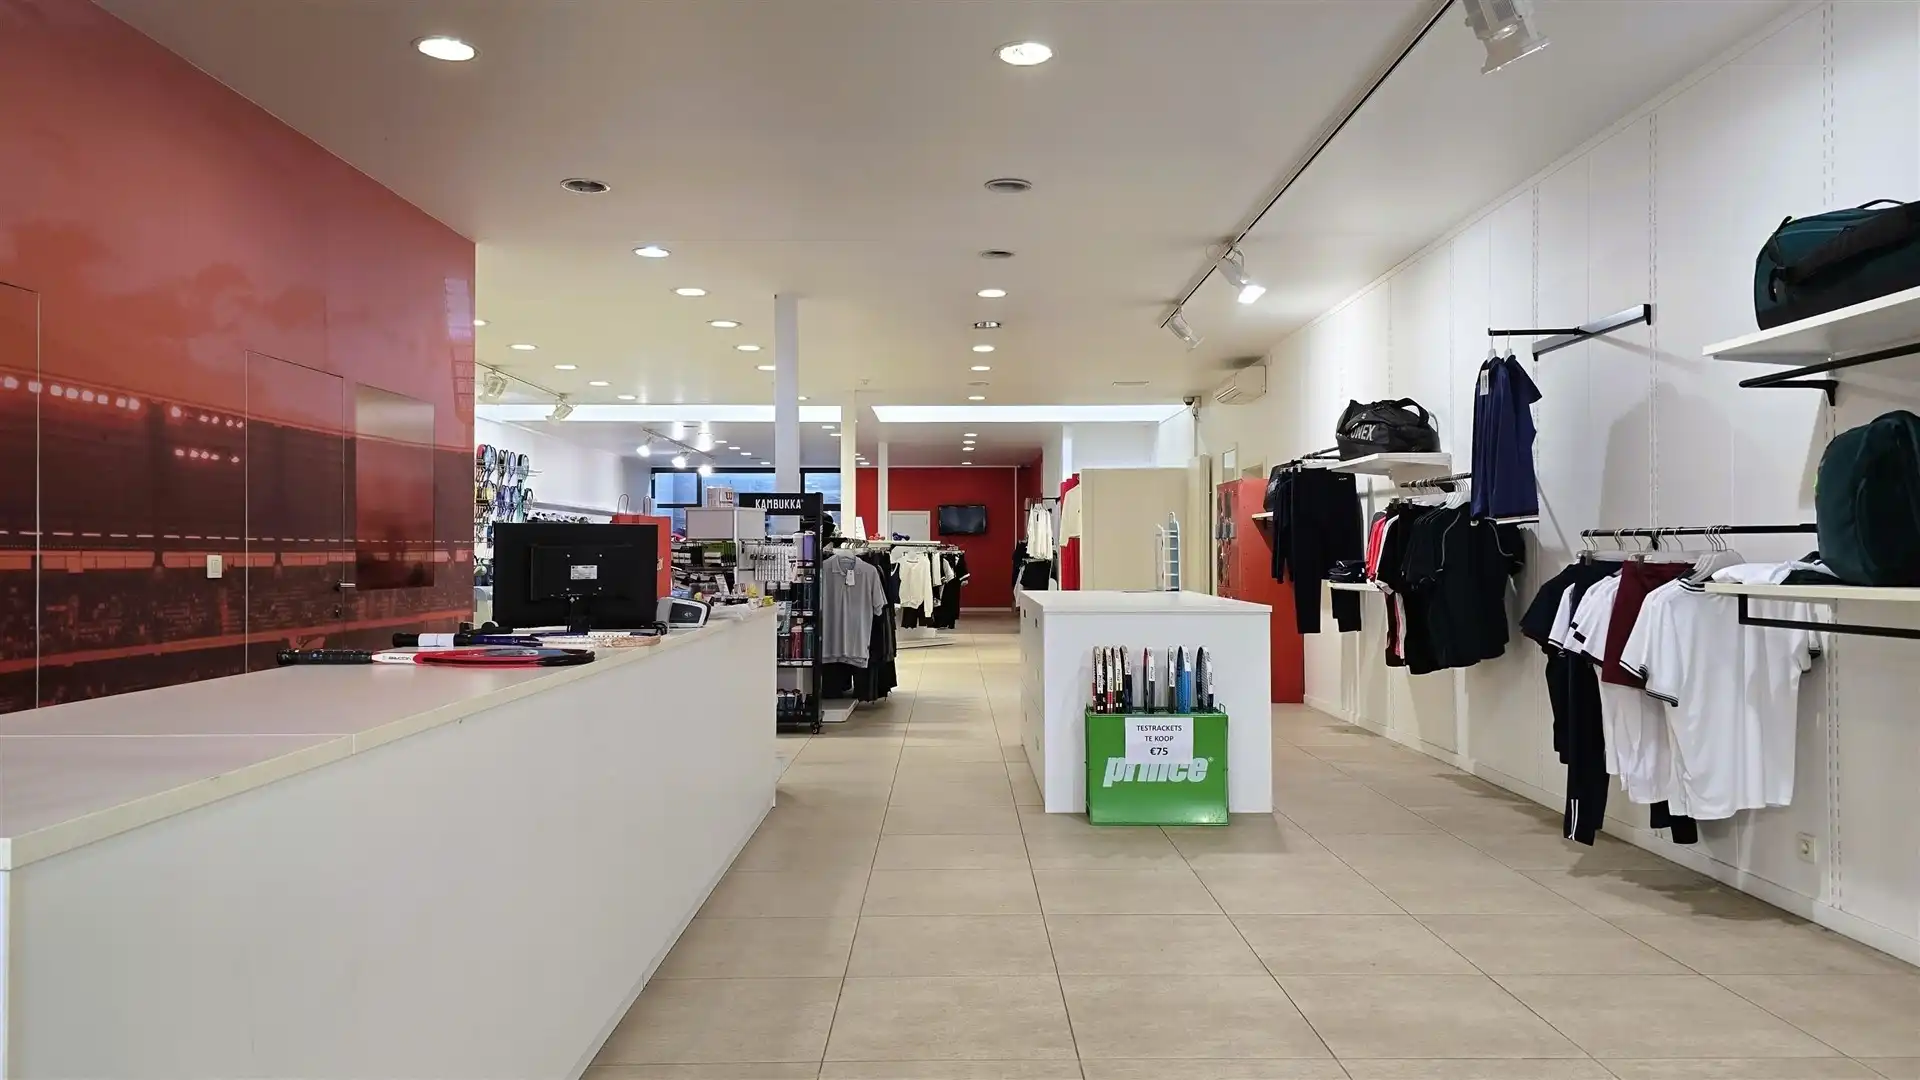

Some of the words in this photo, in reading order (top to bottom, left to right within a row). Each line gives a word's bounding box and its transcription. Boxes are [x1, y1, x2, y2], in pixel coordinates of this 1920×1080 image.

[1350, 424, 1376, 441] ONEX
[755, 498, 802, 510] KAMBUKKA
[1149, 747, 1169, 756] €75
